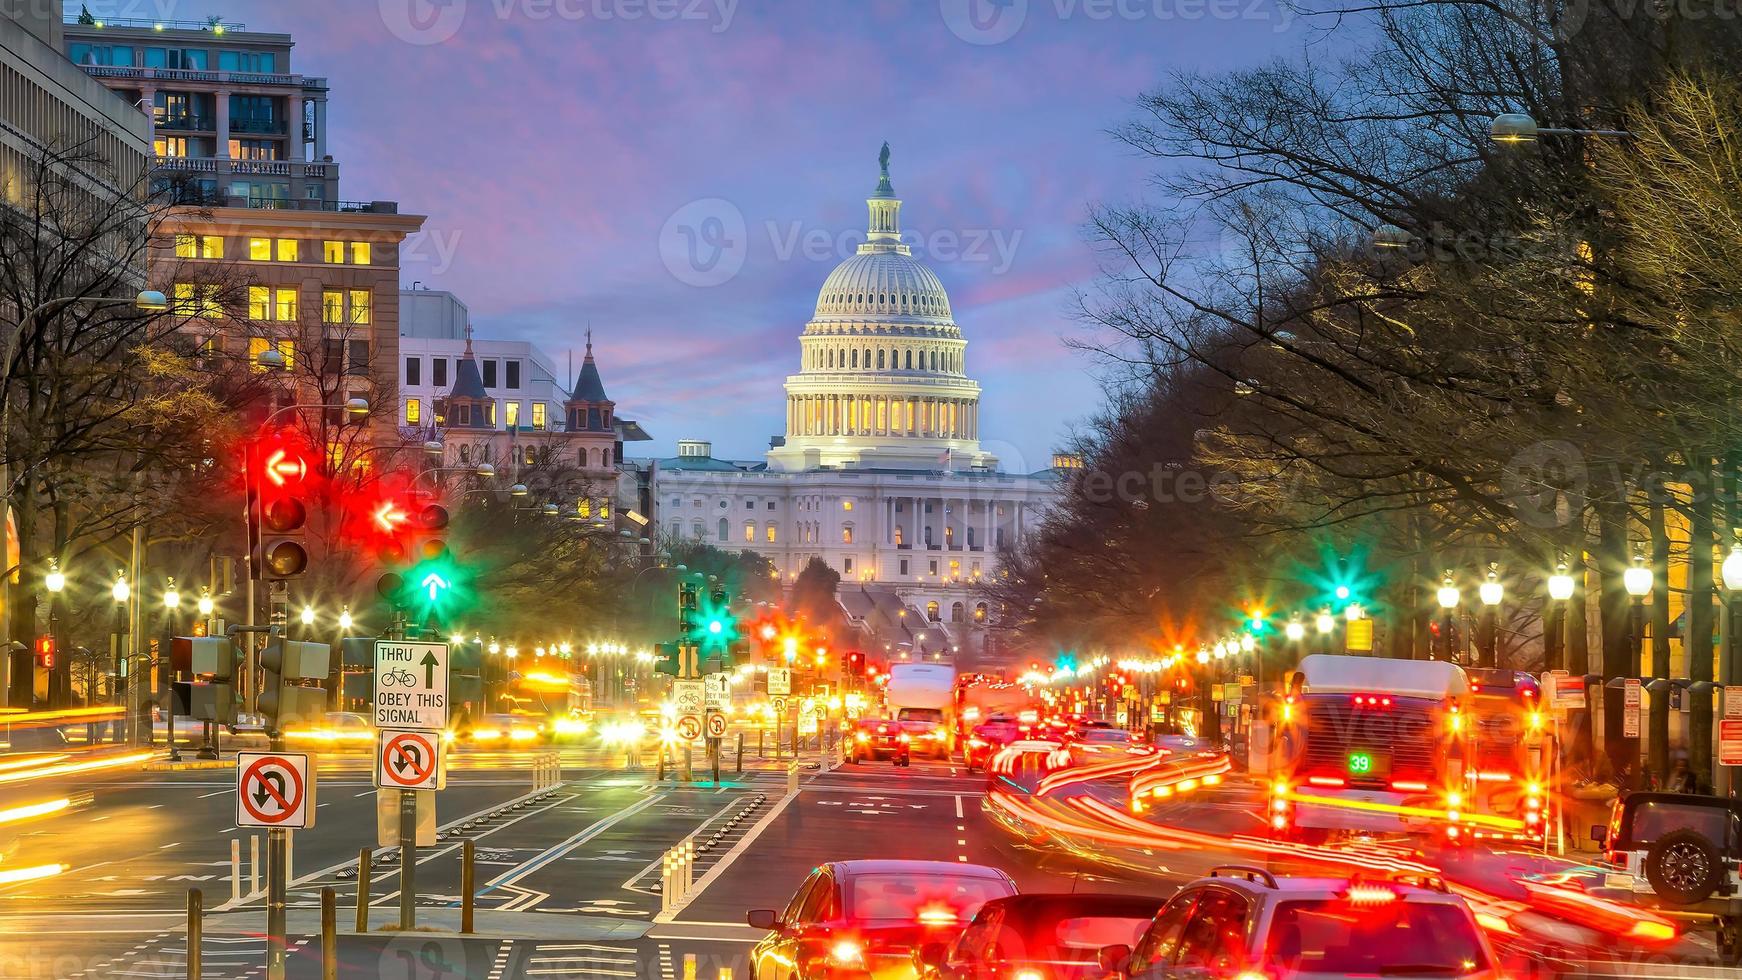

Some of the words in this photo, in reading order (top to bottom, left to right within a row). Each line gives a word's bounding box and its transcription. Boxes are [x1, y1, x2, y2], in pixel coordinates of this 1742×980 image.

[380, 647, 413, 661] THRU
[378, 692, 411, 706] OBEY
[417, 693, 444, 708] THIS
[378, 708, 422, 723] SIGNAL
[1351, 755, 1369, 771] 39
